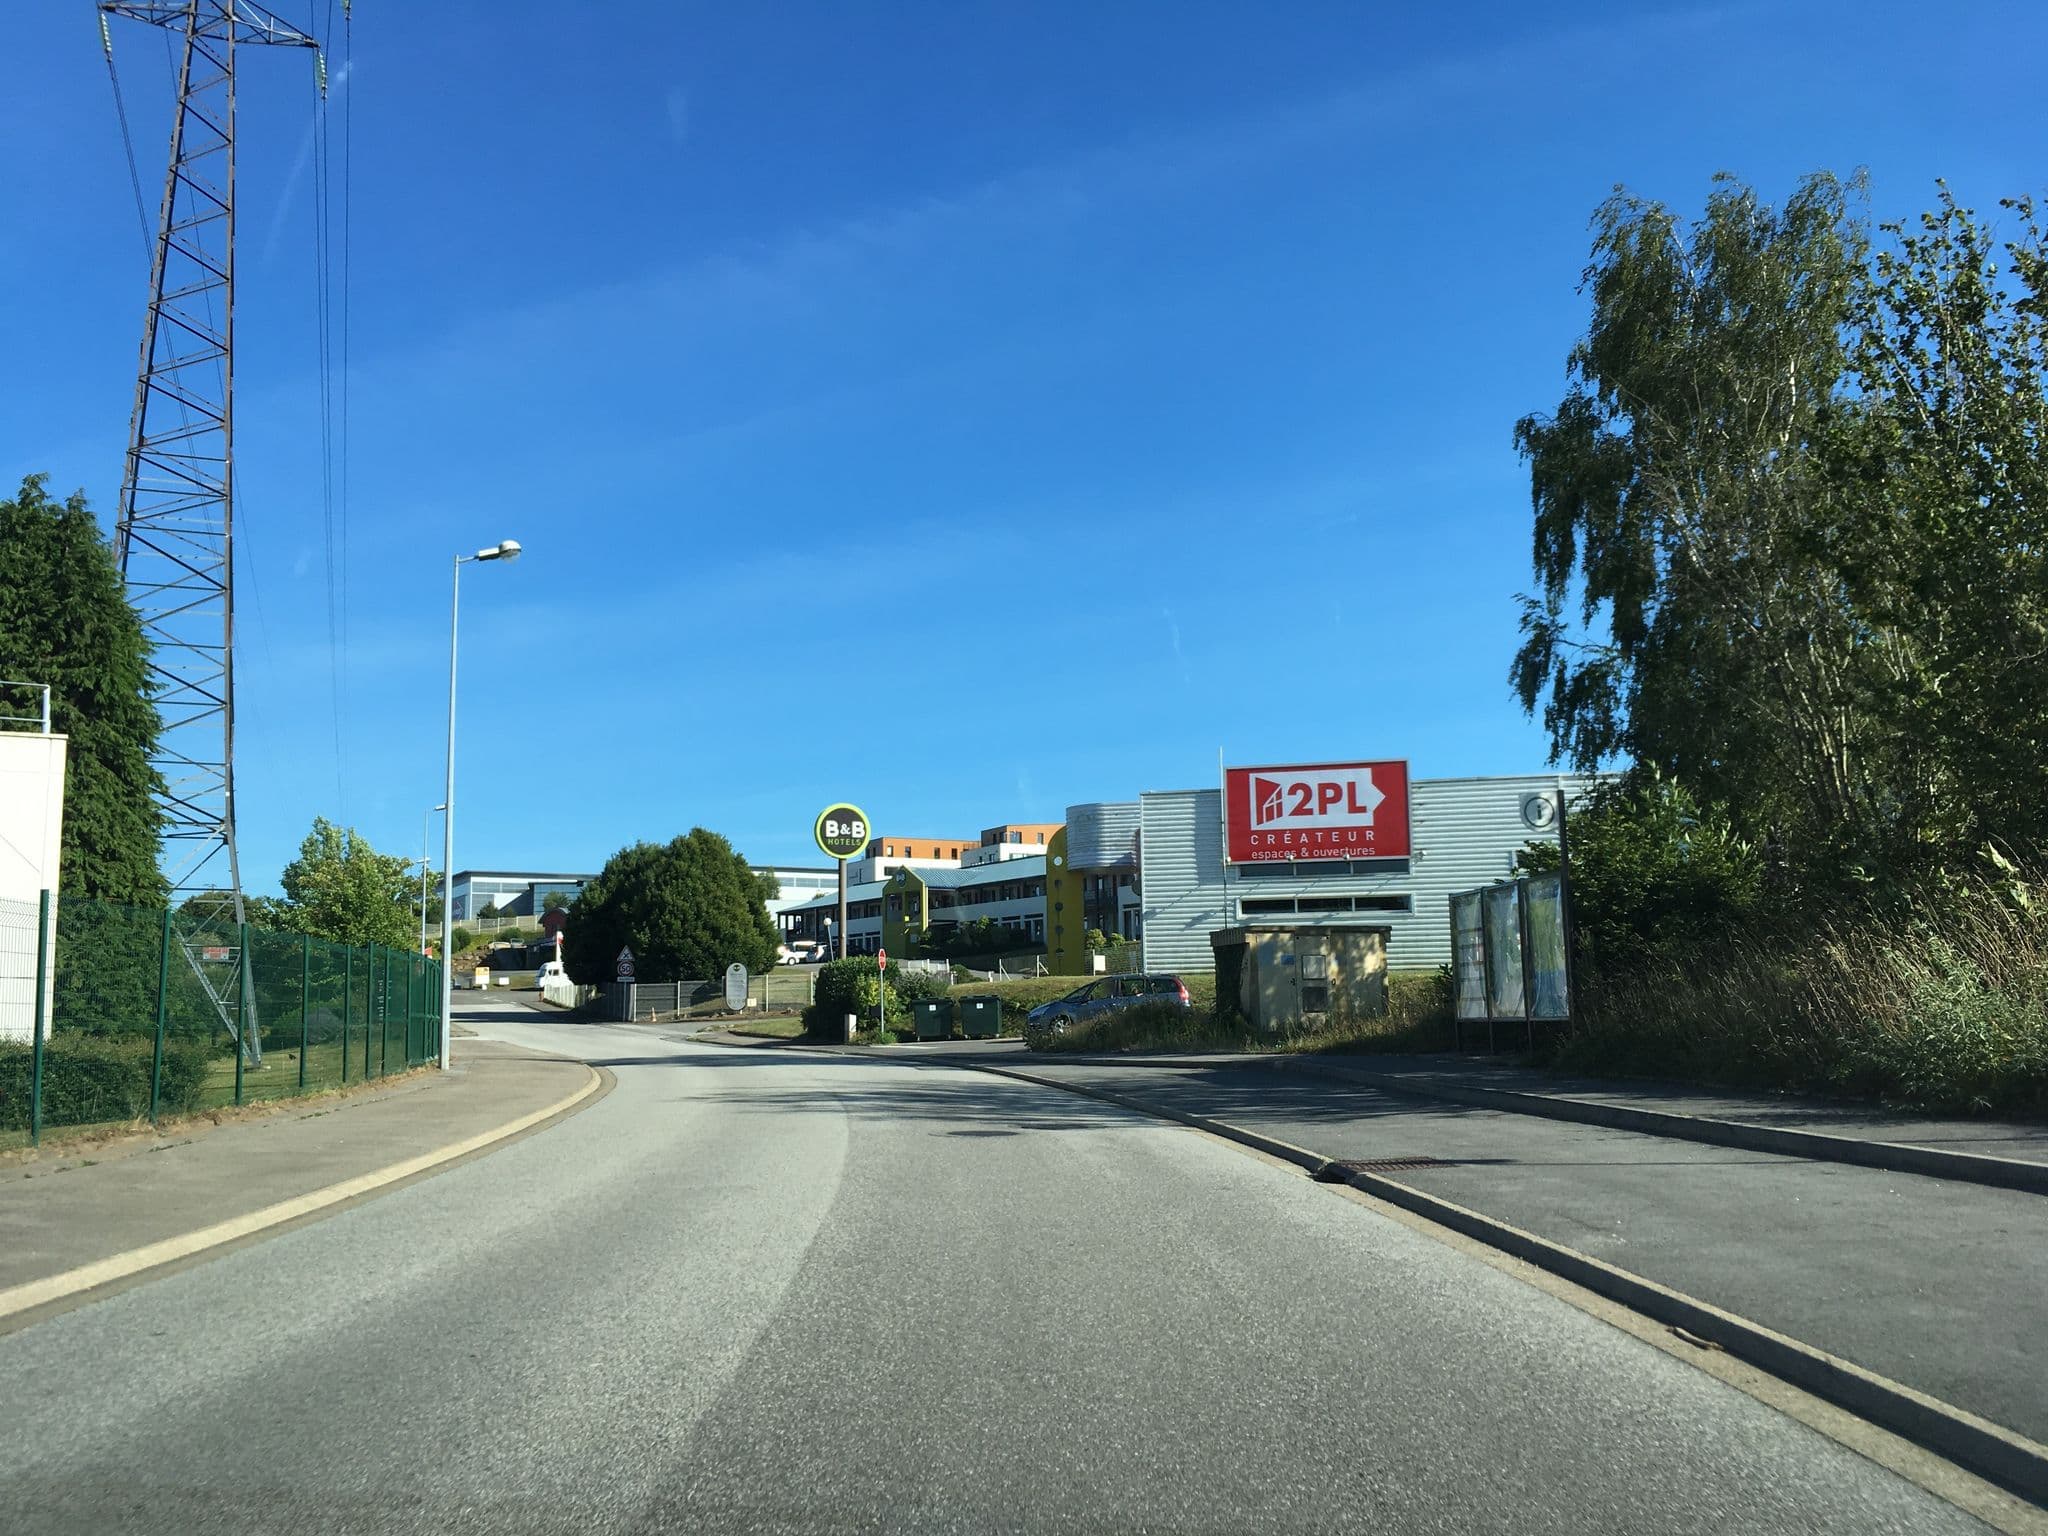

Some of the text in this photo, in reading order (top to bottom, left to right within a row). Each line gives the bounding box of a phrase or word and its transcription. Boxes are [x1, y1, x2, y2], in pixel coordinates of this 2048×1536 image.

[1287, 782, 1367, 816] 2PL
[825, 820, 866, 838] B&B
[827, 838, 861, 846] HOTELS
[1250, 830, 1375, 845] CRÉATEUR
[1251, 847, 1376, 861] espaces & ouvertures
